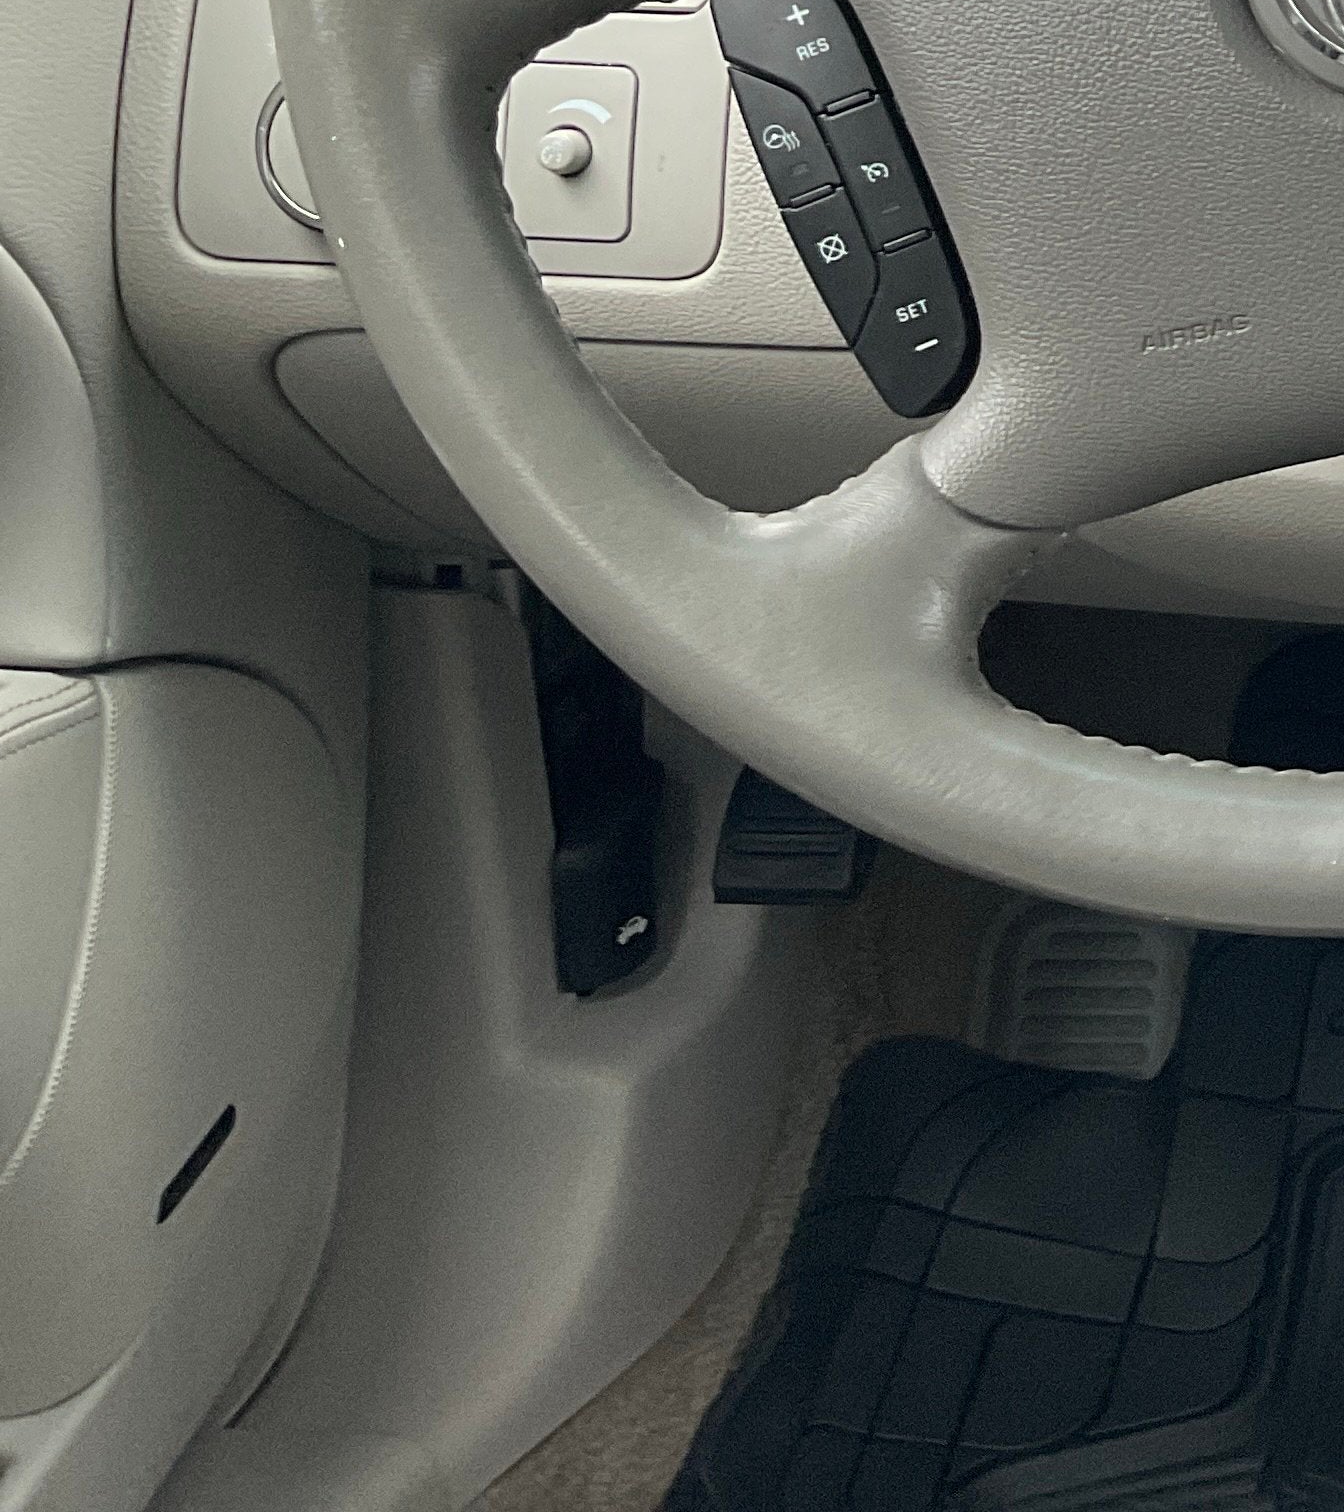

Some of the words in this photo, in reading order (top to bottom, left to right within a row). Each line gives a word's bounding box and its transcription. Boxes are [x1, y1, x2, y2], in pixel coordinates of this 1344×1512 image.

[796, 37, 830, 61] RES
[895, 299, 929, 323] SET
[1143, 314, 1252, 354] AIRBAG
